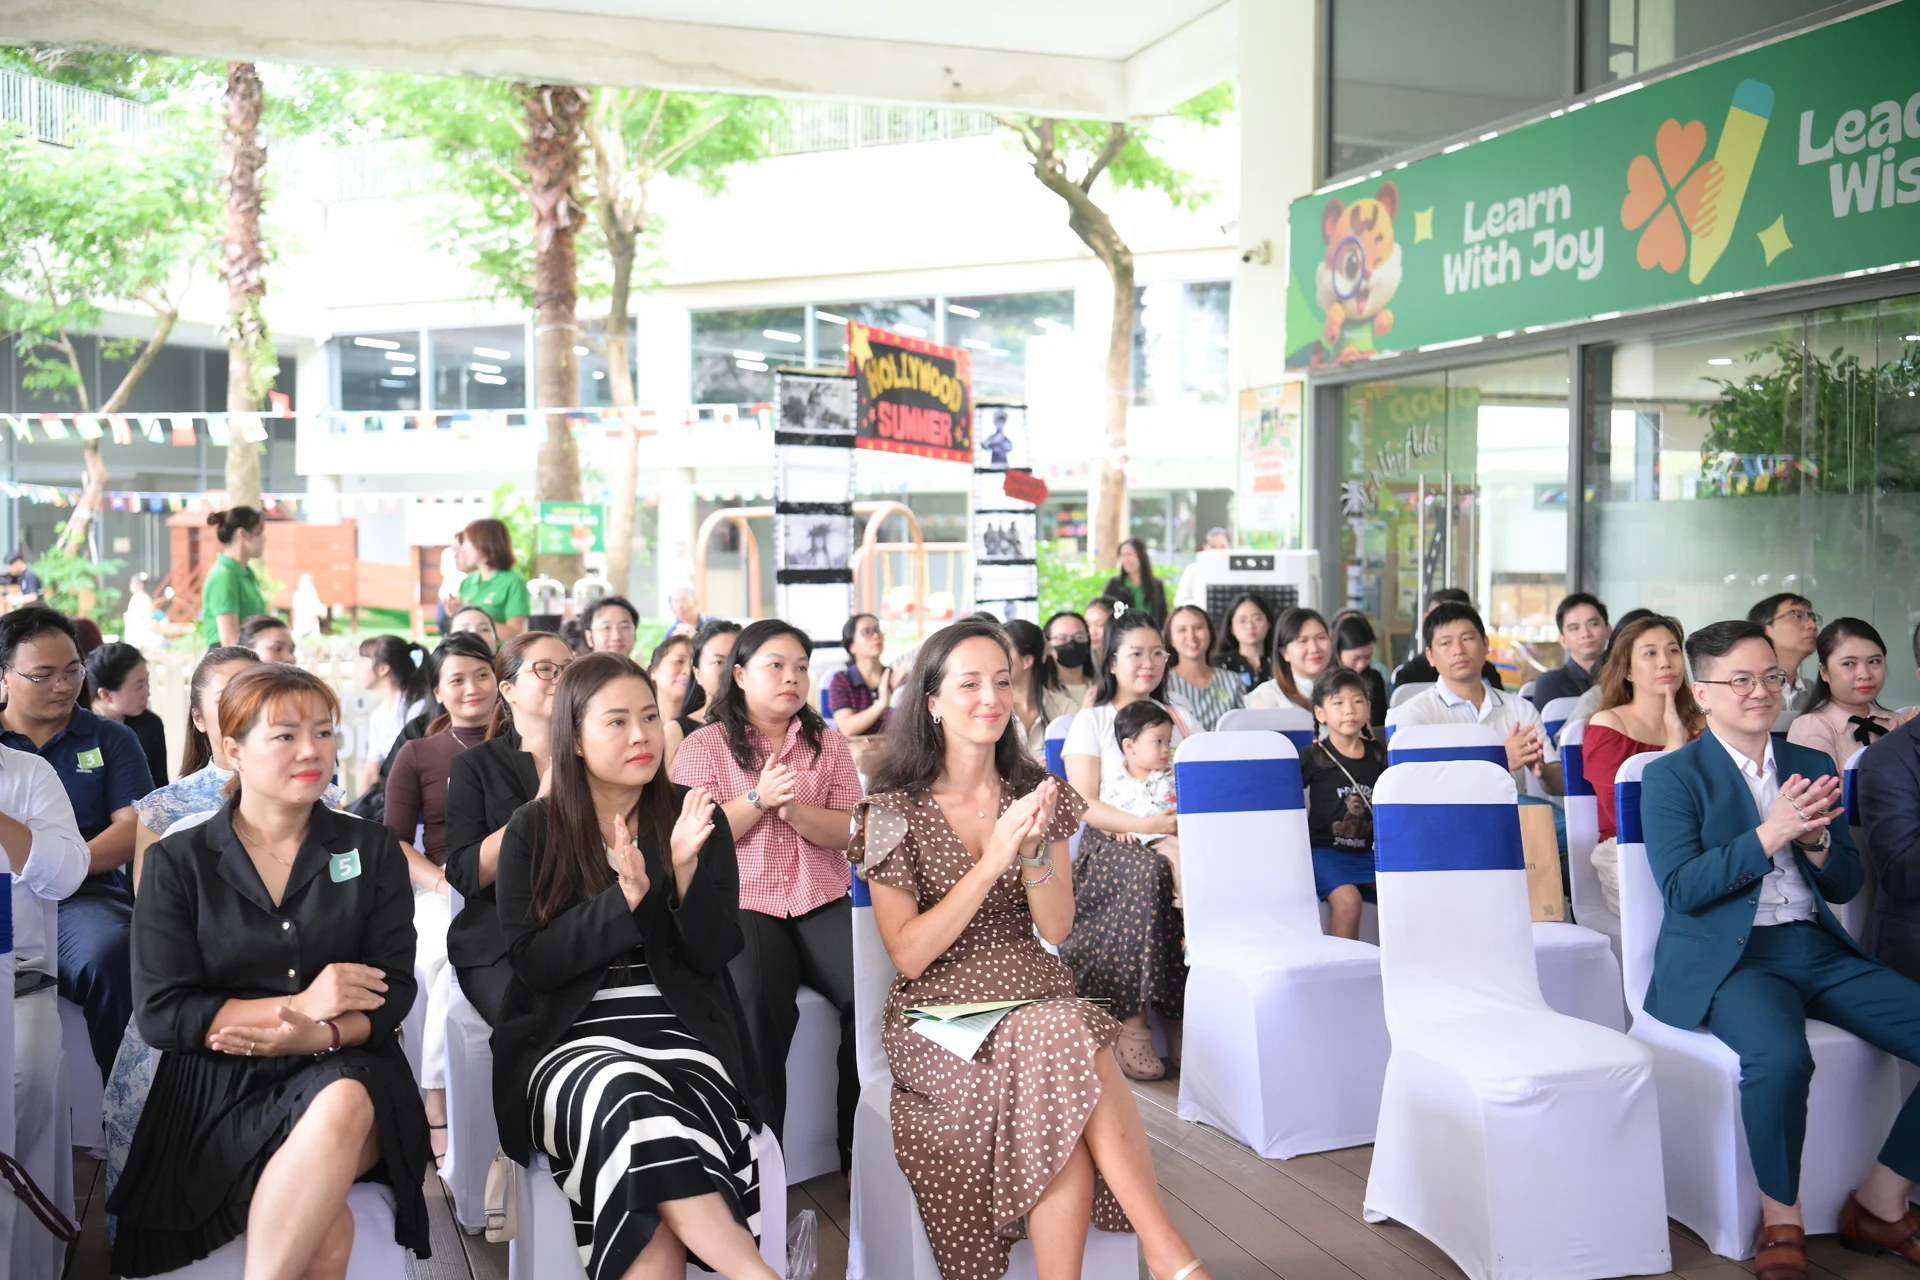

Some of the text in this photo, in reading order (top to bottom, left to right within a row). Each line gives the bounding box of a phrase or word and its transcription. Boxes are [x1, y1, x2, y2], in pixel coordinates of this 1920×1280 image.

[1463, 184, 1571, 245] Learn
[1443, 226, 1604, 295] With Joy
[865, 352, 962, 412] HOLLYWOOD
[877, 401, 952, 447] SUMMER
[85, 753, 95, 766] 3
[338, 857, 352, 876] 5
